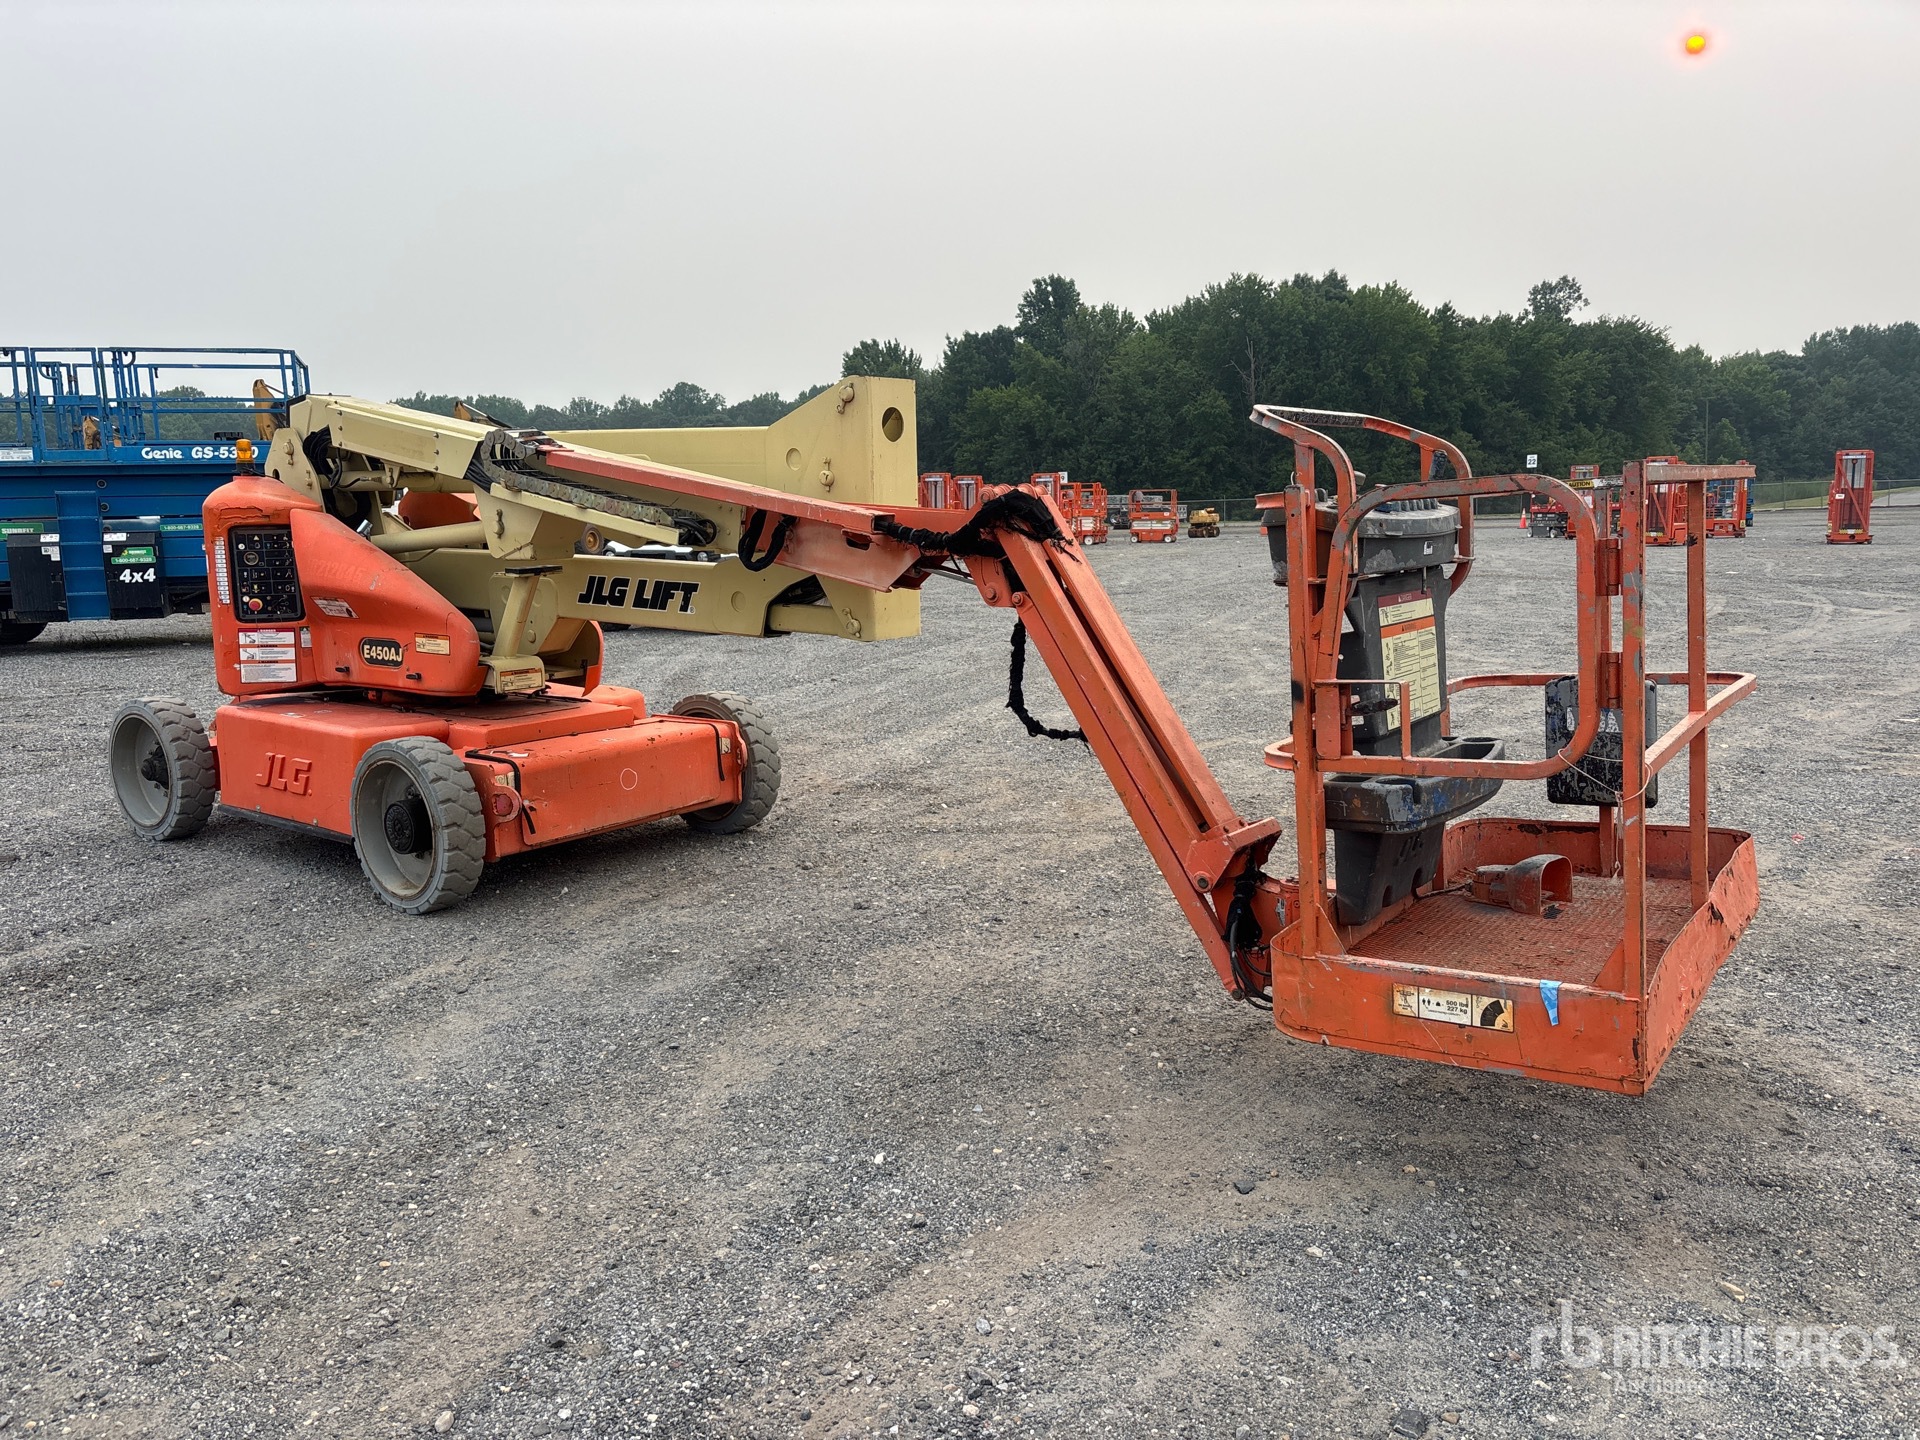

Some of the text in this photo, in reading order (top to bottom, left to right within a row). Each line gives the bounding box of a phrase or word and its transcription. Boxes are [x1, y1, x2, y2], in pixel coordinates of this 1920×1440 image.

[141, 446, 259, 459] Genie GS-530
[119, 567, 156, 583] 4x4
[577, 575, 701, 614] JLG LIFT
[363, 644, 403, 662] E450AJ
[255, 752, 312, 796] JLG
